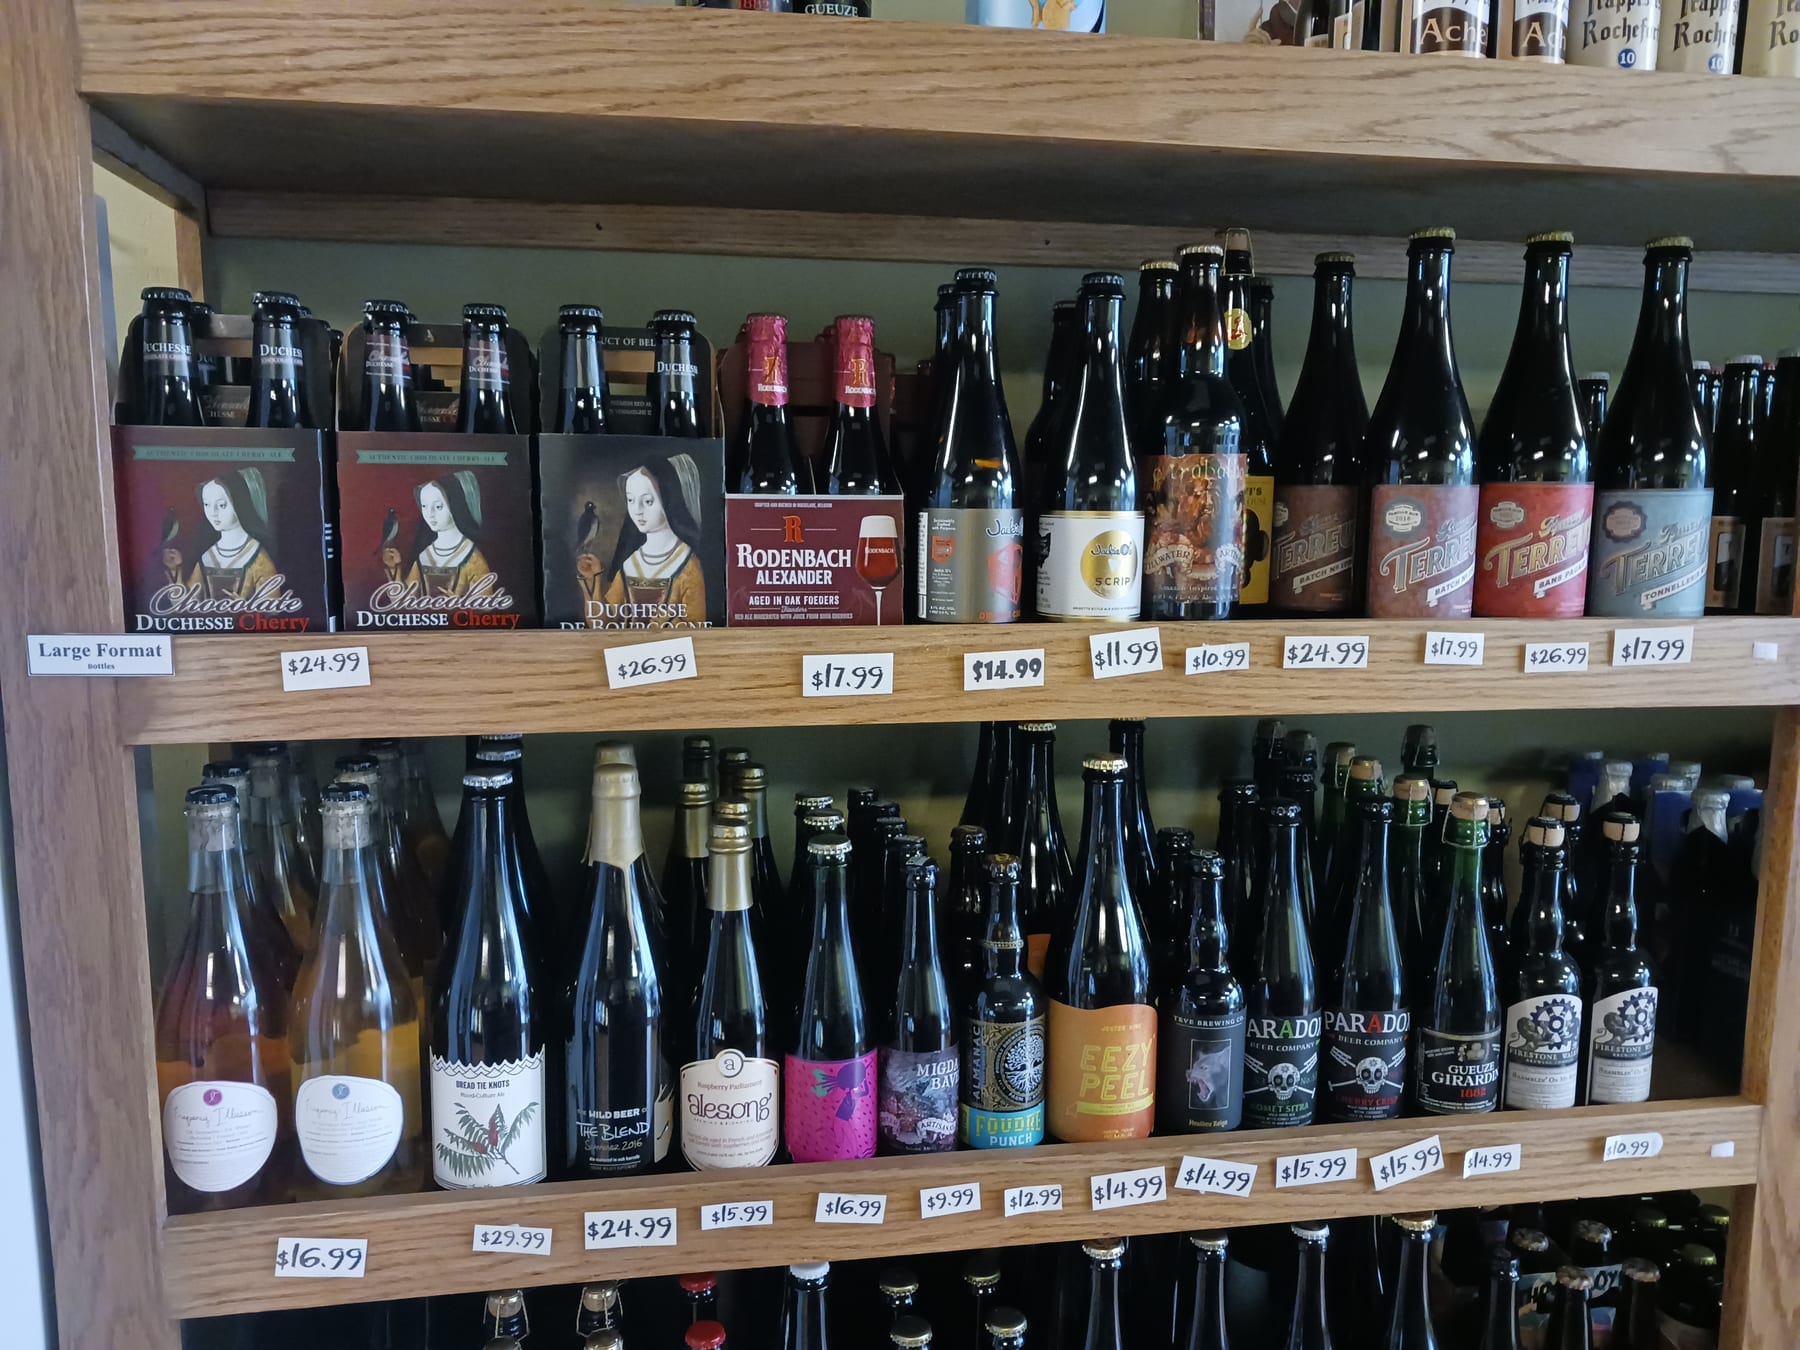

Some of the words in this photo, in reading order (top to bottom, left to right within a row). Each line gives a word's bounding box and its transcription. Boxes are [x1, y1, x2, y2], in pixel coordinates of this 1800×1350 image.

[805, 3, 859, 17] GUEUZE
[1619, 51, 1635, 64] 10
[1709, 57, 1723, 70] 10
[622, 337, 637, 346] OF
[782, 515, 805, 544] R
[736, 543, 852, 569] RODENBACH
[756, 569, 832, 585] ALEXANDER
[1095, 577, 1131, 586] SCRIP
[150, 573, 304, 616] Chocolate
[370, 572, 515, 613] Chocolate
[749, 595, 771, 606] AGED
[773, 595, 782, 605] IN
[784, 595, 801, 606] OAK
[803, 595, 840, 606] FOEDERS
[586, 600, 688, 618] DUCHESSE
[136, 613, 235, 631] DUCHESSE
[238, 614, 310, 632] Cherry
[356, 610, 450, 627] DUCHESSE
[453, 610, 521, 630] Cherry
[39, 642, 91, 661] Large
[96, 642, 163, 658] Format
[1094, 640, 1159, 670] $11.99
[1286, 642, 1366, 665] $24.99
[1430, 636, 1479, 658] $17.99
[1529, 647, 1587, 666] $26.99
[1621, 636, 1685, 662] $17.99
[288, 652, 360, 676] $24.99
[618, 653, 686, 680] $26.99
[972, 657, 1043, 683] $14.99
[1192, 649, 1246, 670] $10.99
[811, 662, 884, 691] $17.99
[1197, 1018, 1236, 1028] BREWING
[1250, 1041, 1274, 1052] BEER
[1276, 1042, 1315, 1052] COMPANY
[1338, 1035, 1362, 1046] BEER
[1364, 1036, 1403, 1046] COMPANY
[724, 1058, 736, 1071] a
[972, 1025, 984, 1100] ALMANAC
[1080, 1038, 1153, 1073] EEZY
[1447, 1061, 1495, 1075] GUEUZE
[477, 1081, 487, 1090] TIE
[488, 1079, 511, 1090] KNOTS
[1080, 1069, 1150, 1101] PEEL
[588, 1109, 612, 1120] WILD
[613, 1107, 640, 1119] BEER
[687, 1092, 773, 1123] alesong
[1253, 1103, 1285, 1113] OMET
[575, 1121, 599, 1139] THE
[599, 1121, 650, 1142] BLEND
[989, 1131, 1034, 1147] PUNCH
[621, 1138, 643, 1151] 2016
[1606, 1140, 1649, 1157] $10.99
[1281, 1156, 1347, 1181] $15.99
[1379, 1144, 1441, 1182] $15.99
[1467, 1151, 1512, 1169] $14.99
[1183, 1163, 1251, 1193] $14.99
[927, 1188, 974, 1210] $9.99
[1009, 1188, 1062, 1210] $12.99
[1094, 1175, 1163, 1204] $14.99
[711, 1204, 768, 1224] $15.99
[825, 1196, 881, 1217] $16.99
[587, 1216, 672, 1240] $24.99
[480, 1230, 546, 1250] $29.99
[276, 1242, 362, 1270] $16.99
